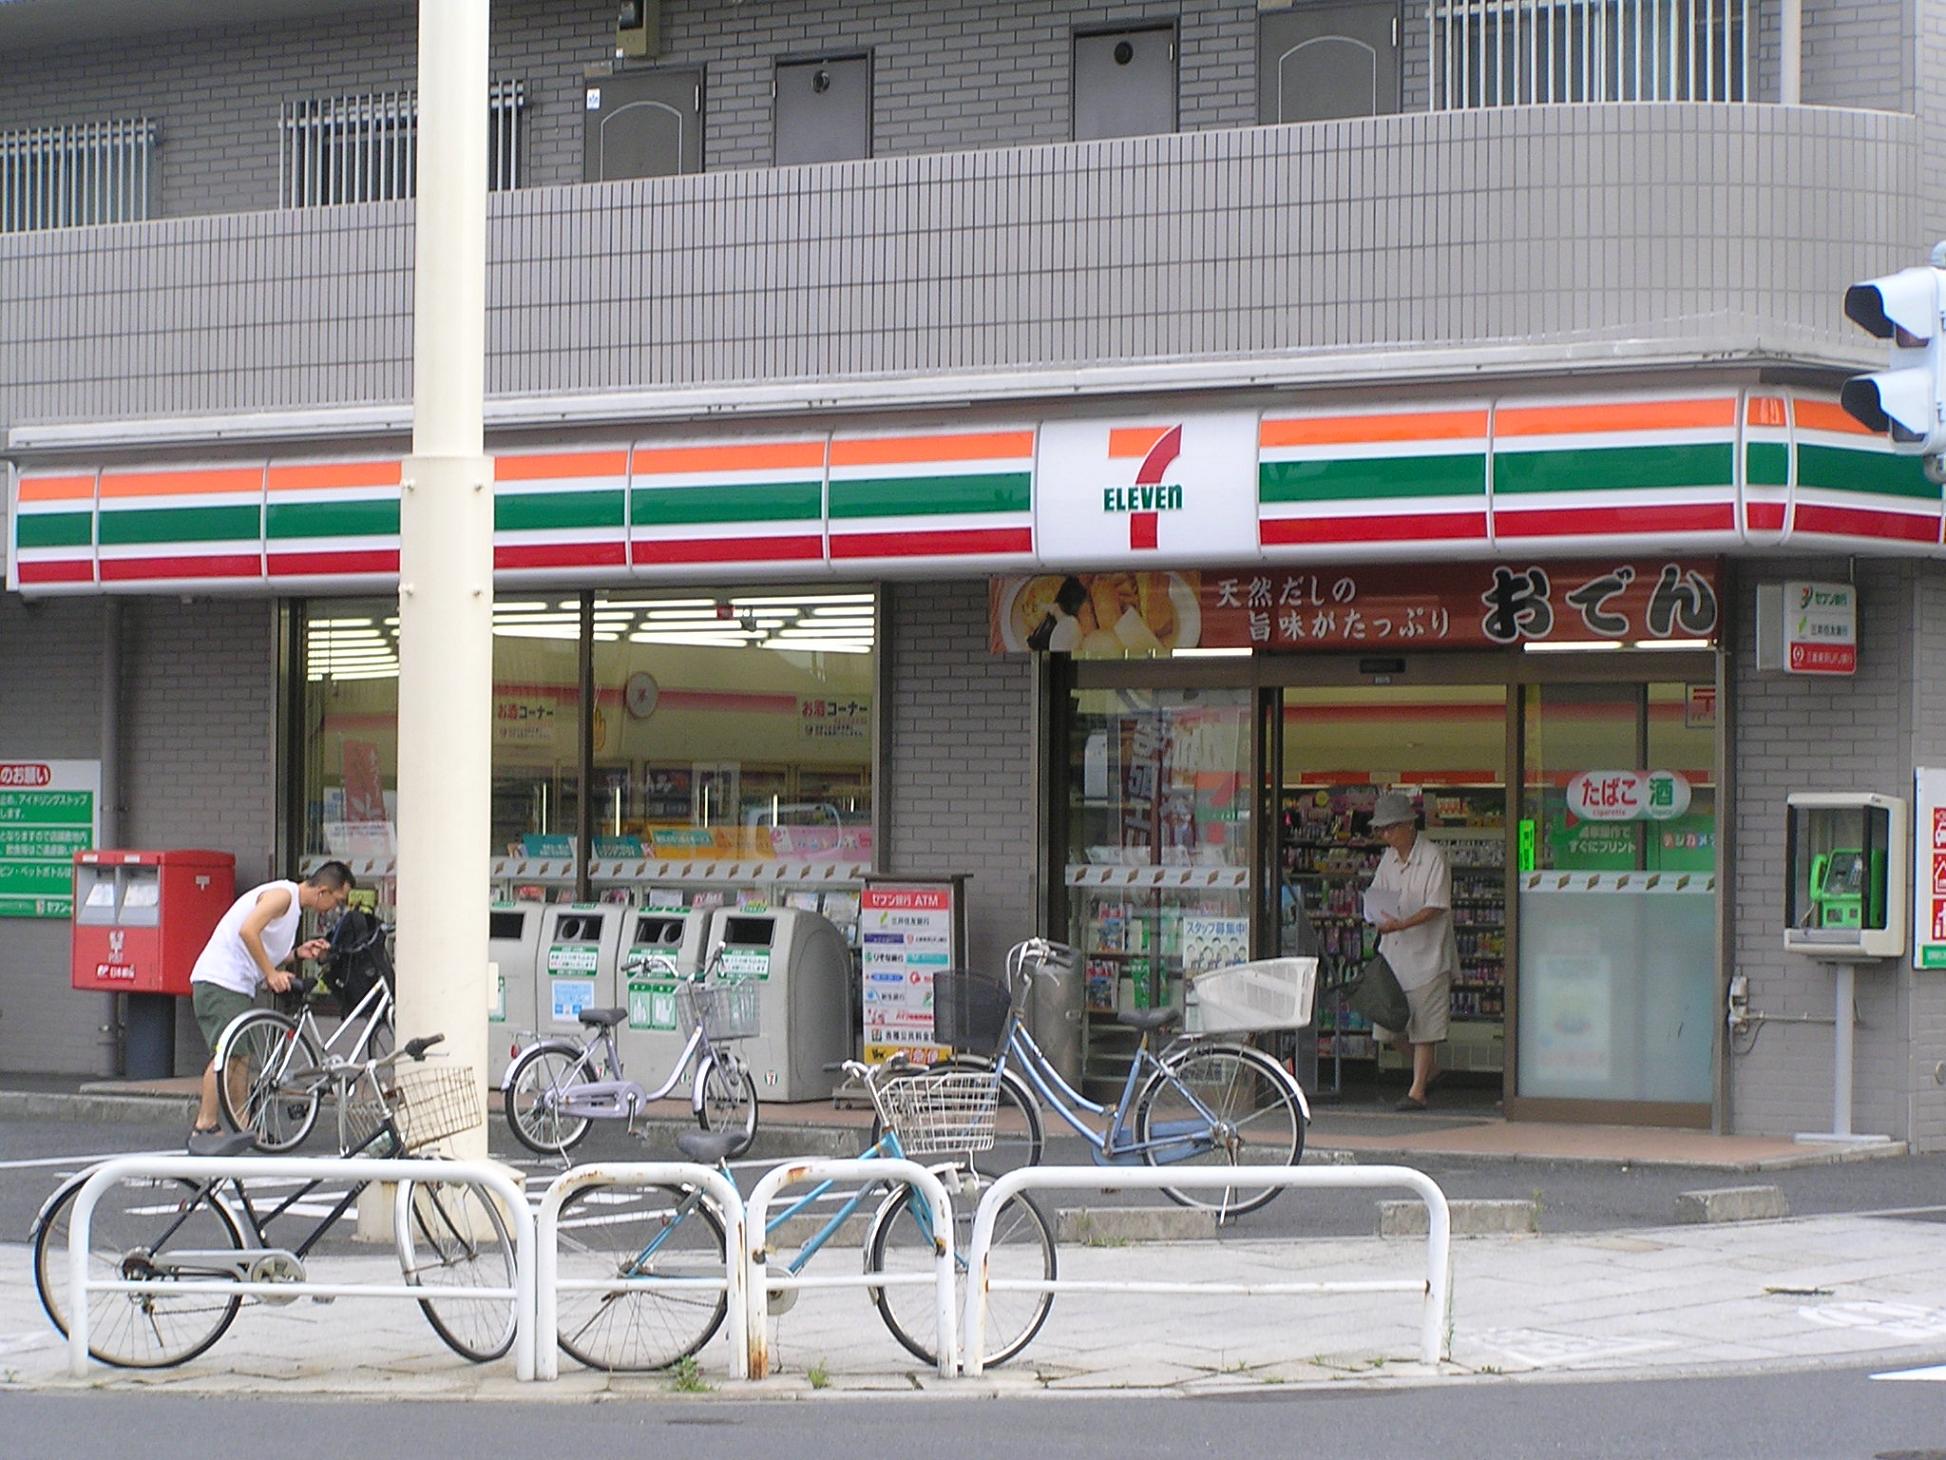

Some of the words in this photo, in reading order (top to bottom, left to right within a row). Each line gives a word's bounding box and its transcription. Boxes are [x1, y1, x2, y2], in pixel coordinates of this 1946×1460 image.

[1109, 424, 1182, 549] 7
[1216, 576, 1356, 607] 天然だしの
[1482, 563, 1718, 643] おでん
[1249, 607, 1450, 642] 旨味がたっぷり
[1582, 778, 1637, 806] たばこ
[1649, 778, 1673, 806] 酒
[914, 894, 939, 906] ATM
